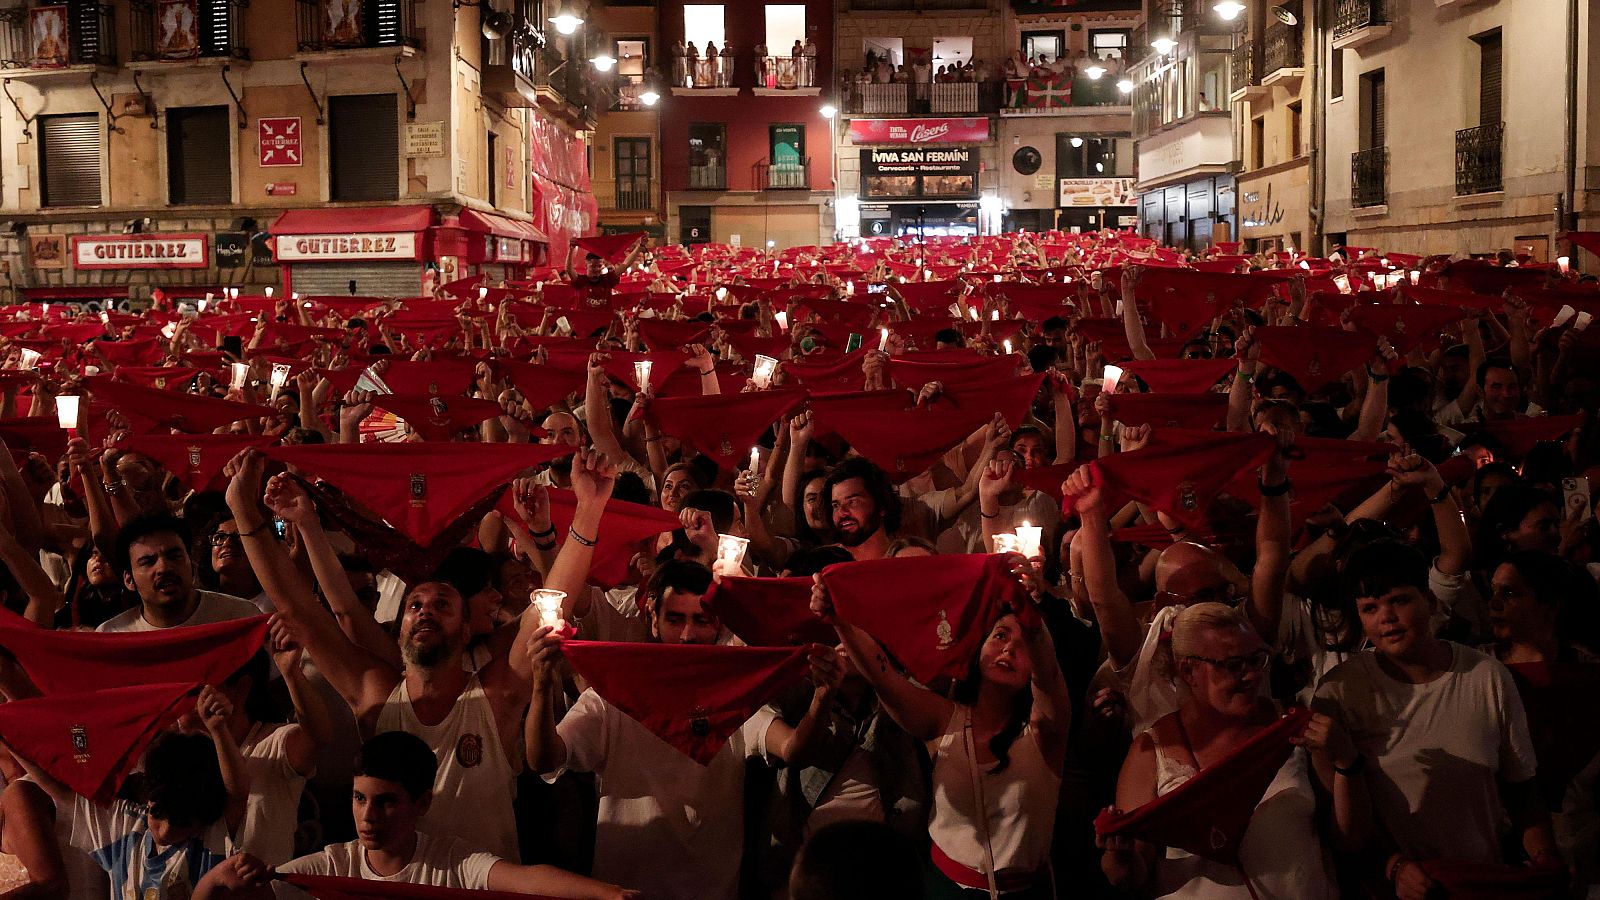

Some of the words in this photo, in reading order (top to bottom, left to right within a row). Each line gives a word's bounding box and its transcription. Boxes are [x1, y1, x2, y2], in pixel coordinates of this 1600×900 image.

[910, 122, 949, 142] Casera
[261, 138, 298, 146] GUTIERREZ
[872, 151, 899, 162] ¡VIVA
[901, 152, 923, 162] SAN
[926, 149, 969, 162] FERMÍN!
[691, 228, 699, 237] 6
[94, 243, 186, 259] GUTIERREZ
[296, 237, 396, 254] GUTIERREZ
